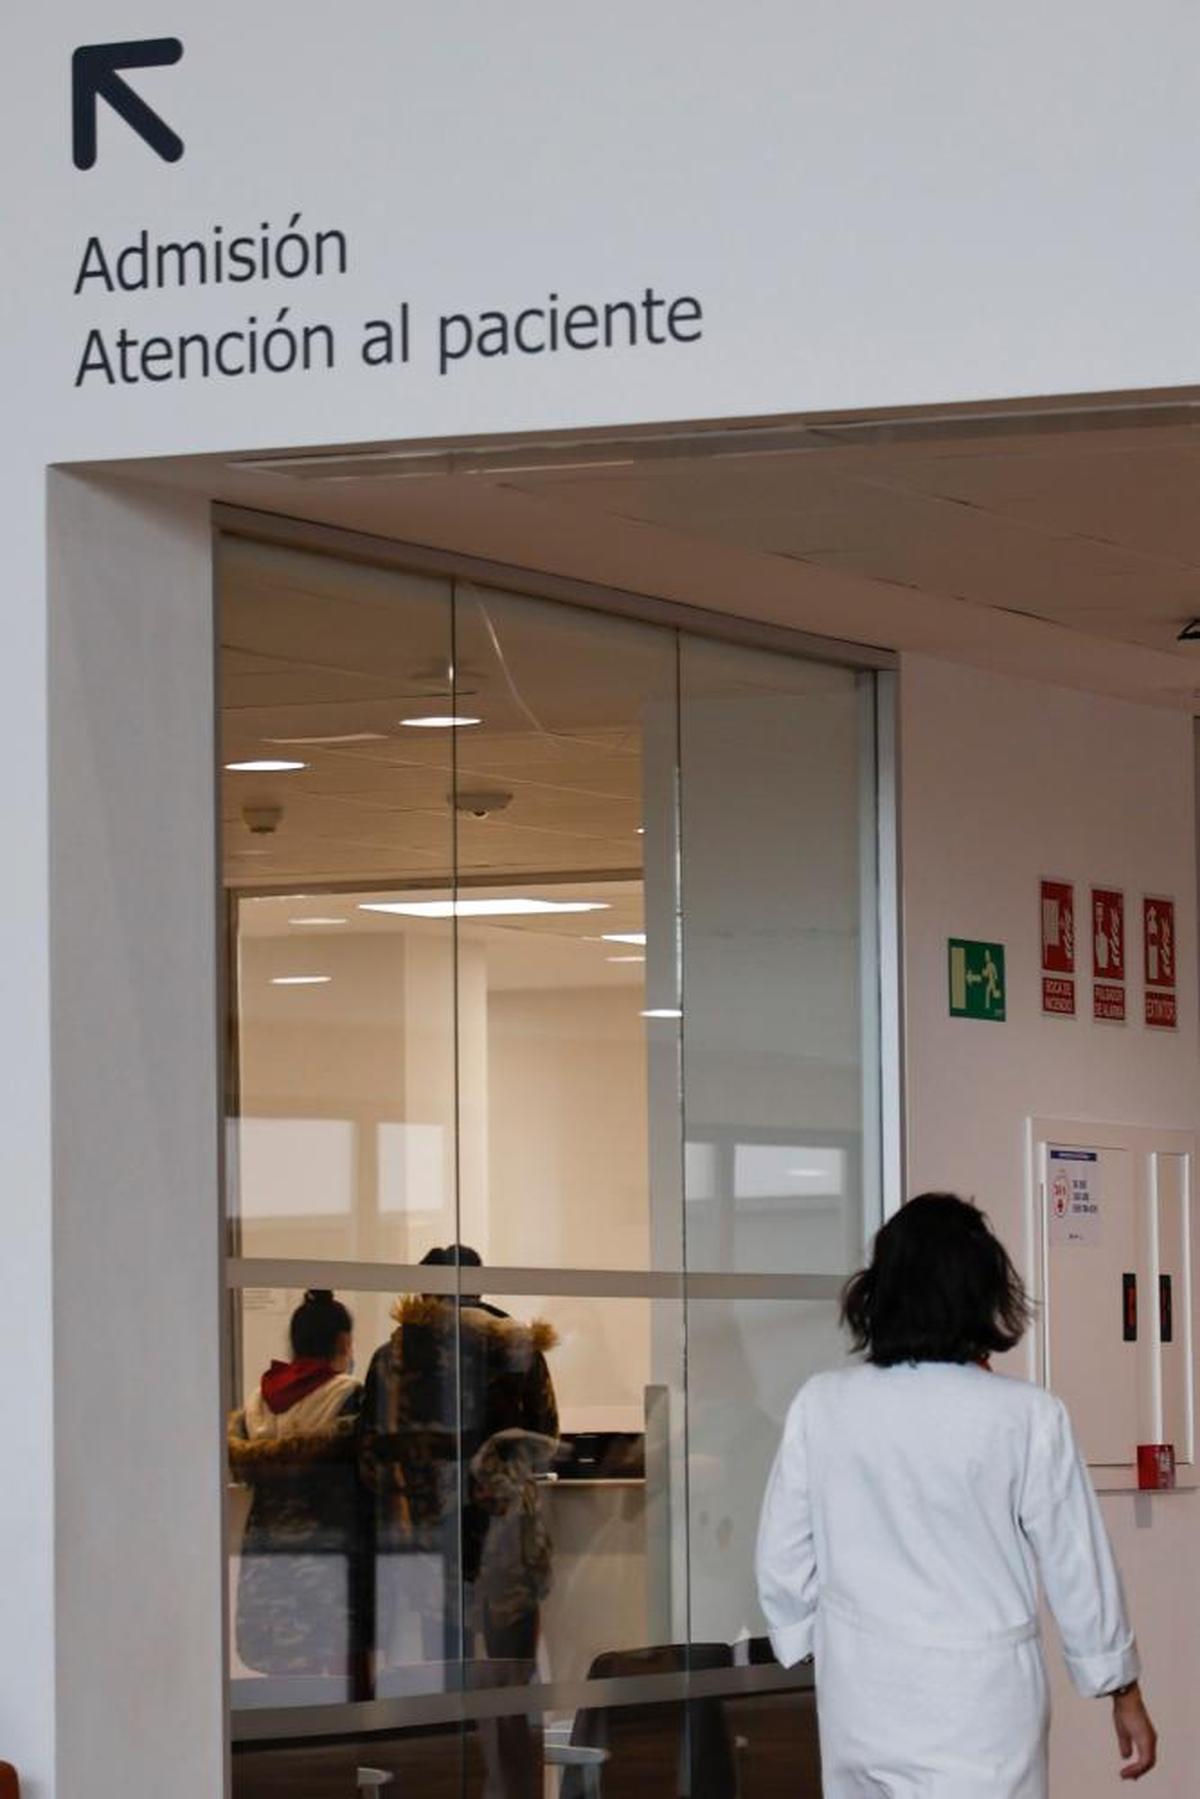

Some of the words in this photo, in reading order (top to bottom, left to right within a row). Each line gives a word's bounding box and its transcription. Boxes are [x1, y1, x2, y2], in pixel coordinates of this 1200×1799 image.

[74, 212, 347, 295] Admisión
[75, 307, 334, 387] Atención
[362, 302, 409, 366] al
[439, 288, 702, 375] paciente
